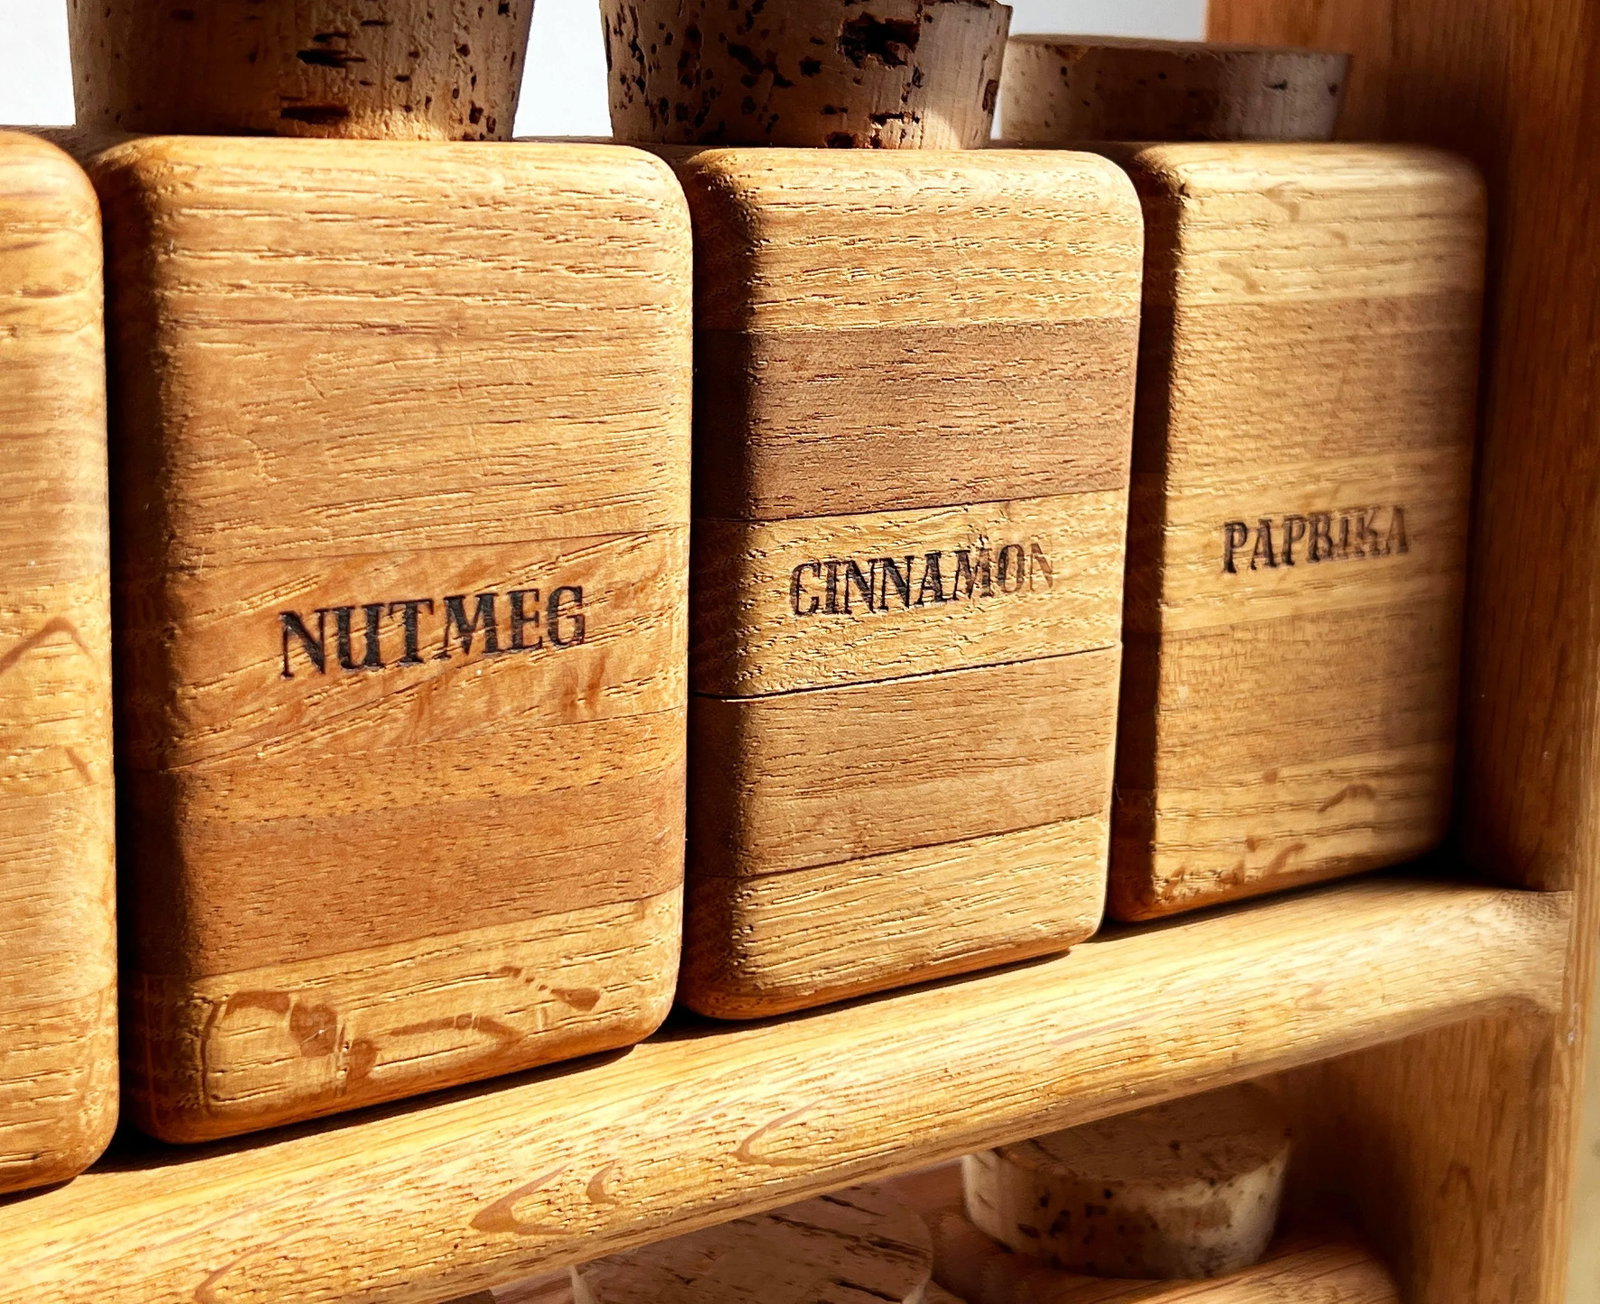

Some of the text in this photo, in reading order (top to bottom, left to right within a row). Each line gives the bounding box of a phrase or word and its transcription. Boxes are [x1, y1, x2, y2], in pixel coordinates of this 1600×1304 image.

[1222, 504, 1410, 574] PAPRIKA
[788, 541, 1055, 616] CINNAMON
[279, 585, 587, 679] NUTMEG
